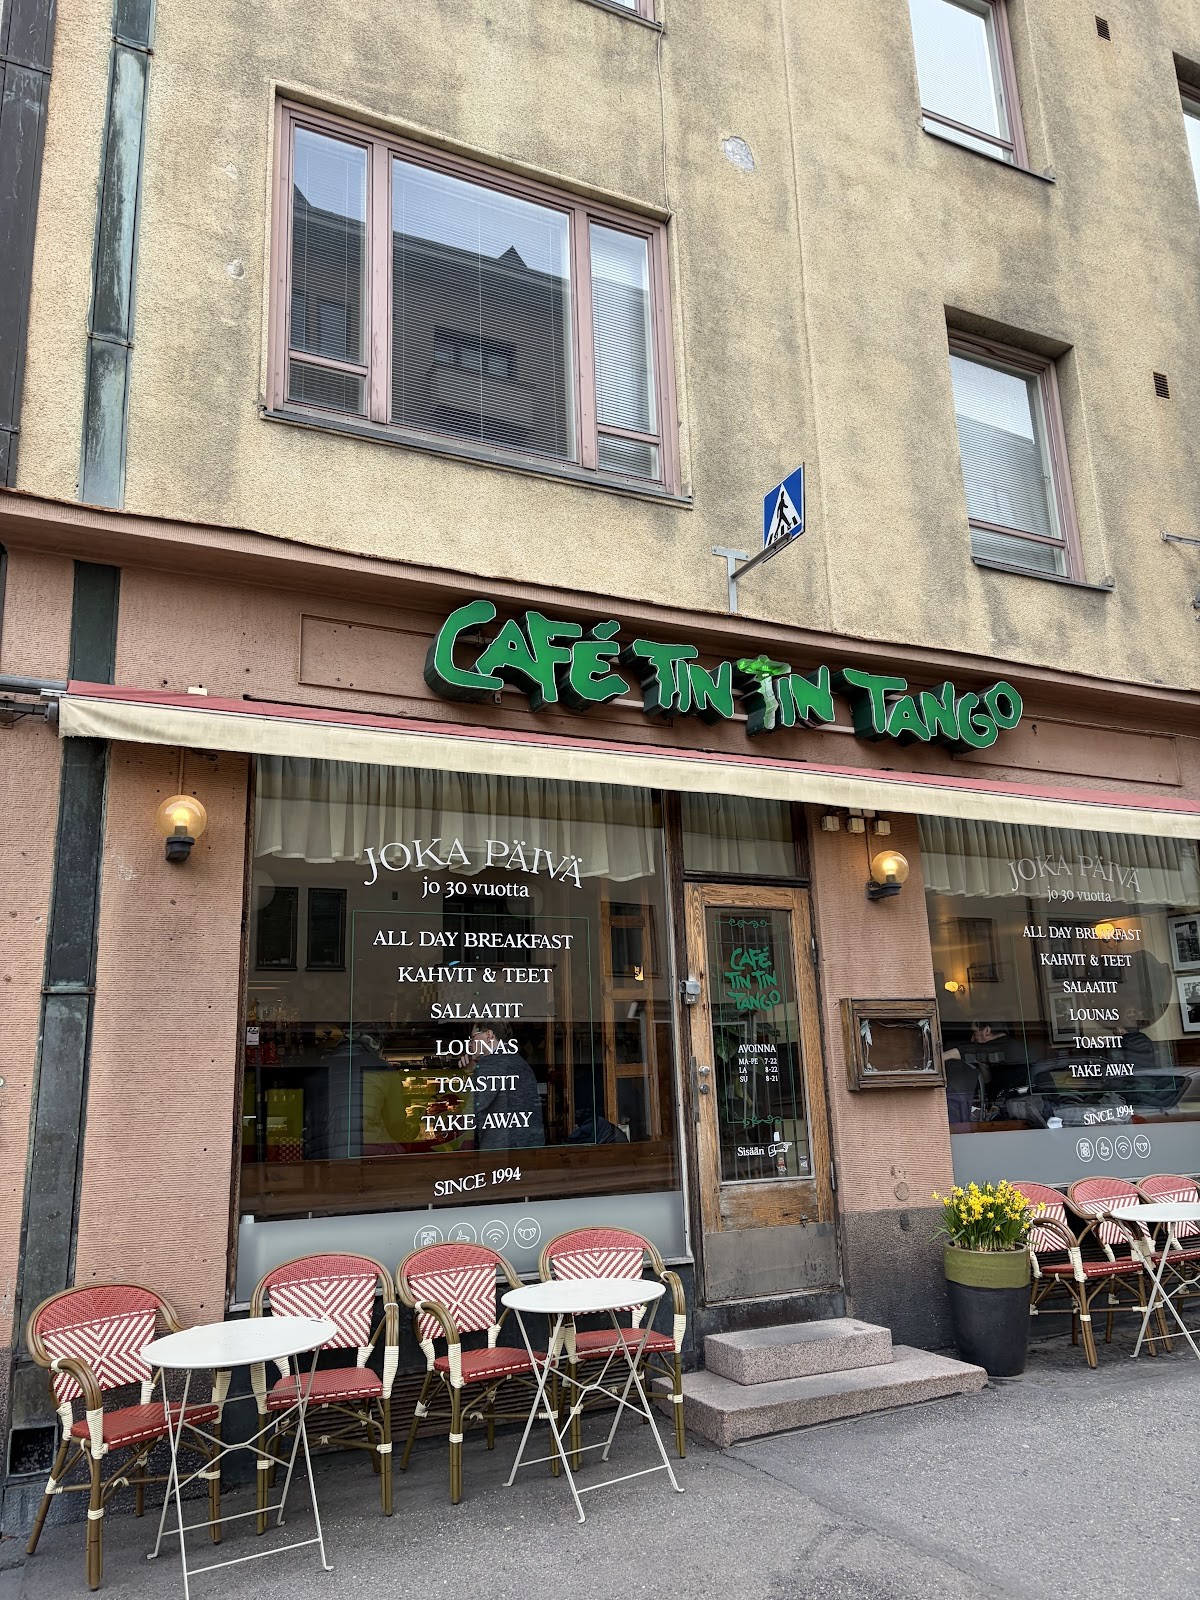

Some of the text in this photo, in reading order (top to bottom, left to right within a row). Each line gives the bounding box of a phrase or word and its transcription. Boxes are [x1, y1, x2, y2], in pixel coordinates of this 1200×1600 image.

[434, 600, 1023, 749] CAFÉ TIN TIN TANGO
[363, 838, 583, 889] JOKA PÄIVÄ
[1008, 854, 1141, 893] JOKA PÄIVÄ
[422, 876, 529, 898] jo 30 vuotta
[1047, 886, 1112, 902] jo 30 vuotta
[373, 930, 573, 950] ALL DAY BREAKFAST
[1023, 926, 1141, 941] ALL DAY BREAKFAST
[731, 947, 772, 970] CAFÉ
[1040, 953, 1131, 967] KAHVIT & TEET
[398, 967, 552, 983] KAHVIT & TEET
[725, 970, 777, 990] TIN TIN
[1064, 981, 1118, 993] SALAATIT
[727, 990, 780, 1011] TANGO
[431, 1003, 523, 1019] SALAATIT
[1070, 1009, 1119, 1021] LOUNAS
[436, 1039, 519, 1056] LOUNAS
[738, 1044, 776, 1053] AVOINNA
[1073, 1036, 1123, 1048] TOASTIT
[1069, 1064, 1134, 1077] TAKE AWAY
[435, 1075, 519, 1093] TOASTIT
[421, 1112, 533, 1132] TAKE AWAY
[1084, 1105, 1134, 1125] SINCE 1994
[738, 1147, 765, 1156] Sisään
[434, 1167, 521, 1197] SINCE 1994
